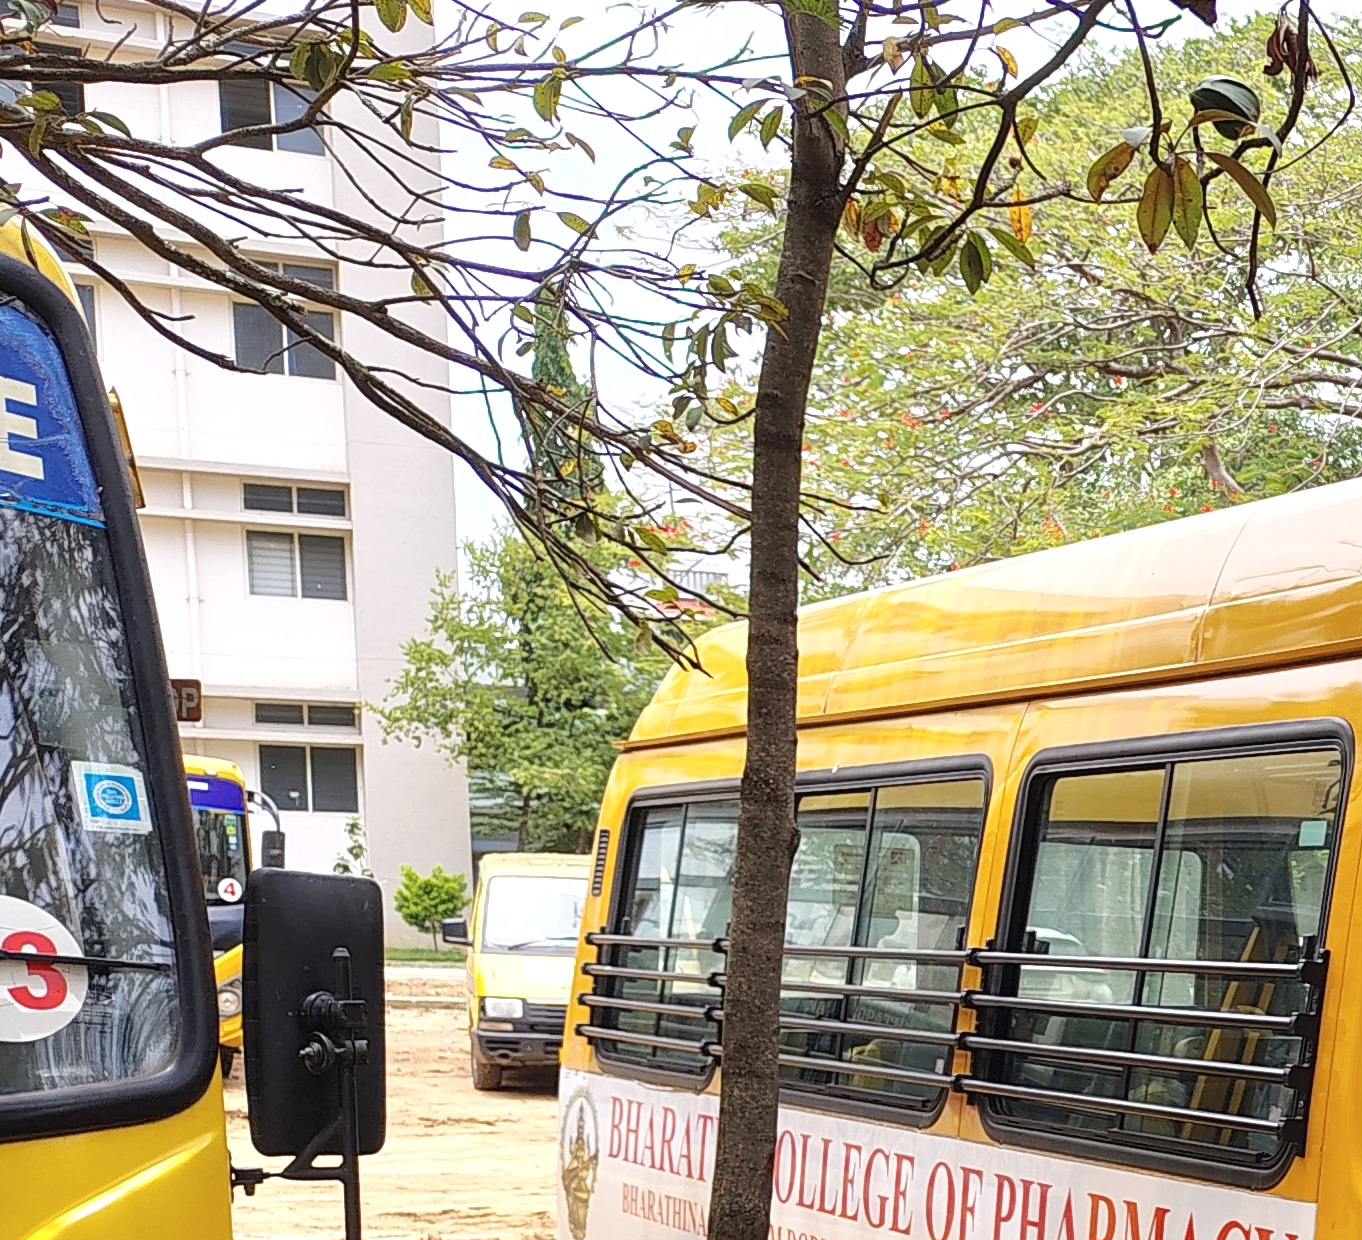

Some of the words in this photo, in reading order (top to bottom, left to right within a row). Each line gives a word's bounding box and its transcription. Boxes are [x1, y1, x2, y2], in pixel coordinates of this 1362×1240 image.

[224, 883, 236, 897] 4
[1, 931, 68, 1010] 3
[607, 1096, 719, 1183] BHARAT
[773, 1130, 916, 1236] OLLEGE
[622, 1182, 709, 1238] BHARATHINA
